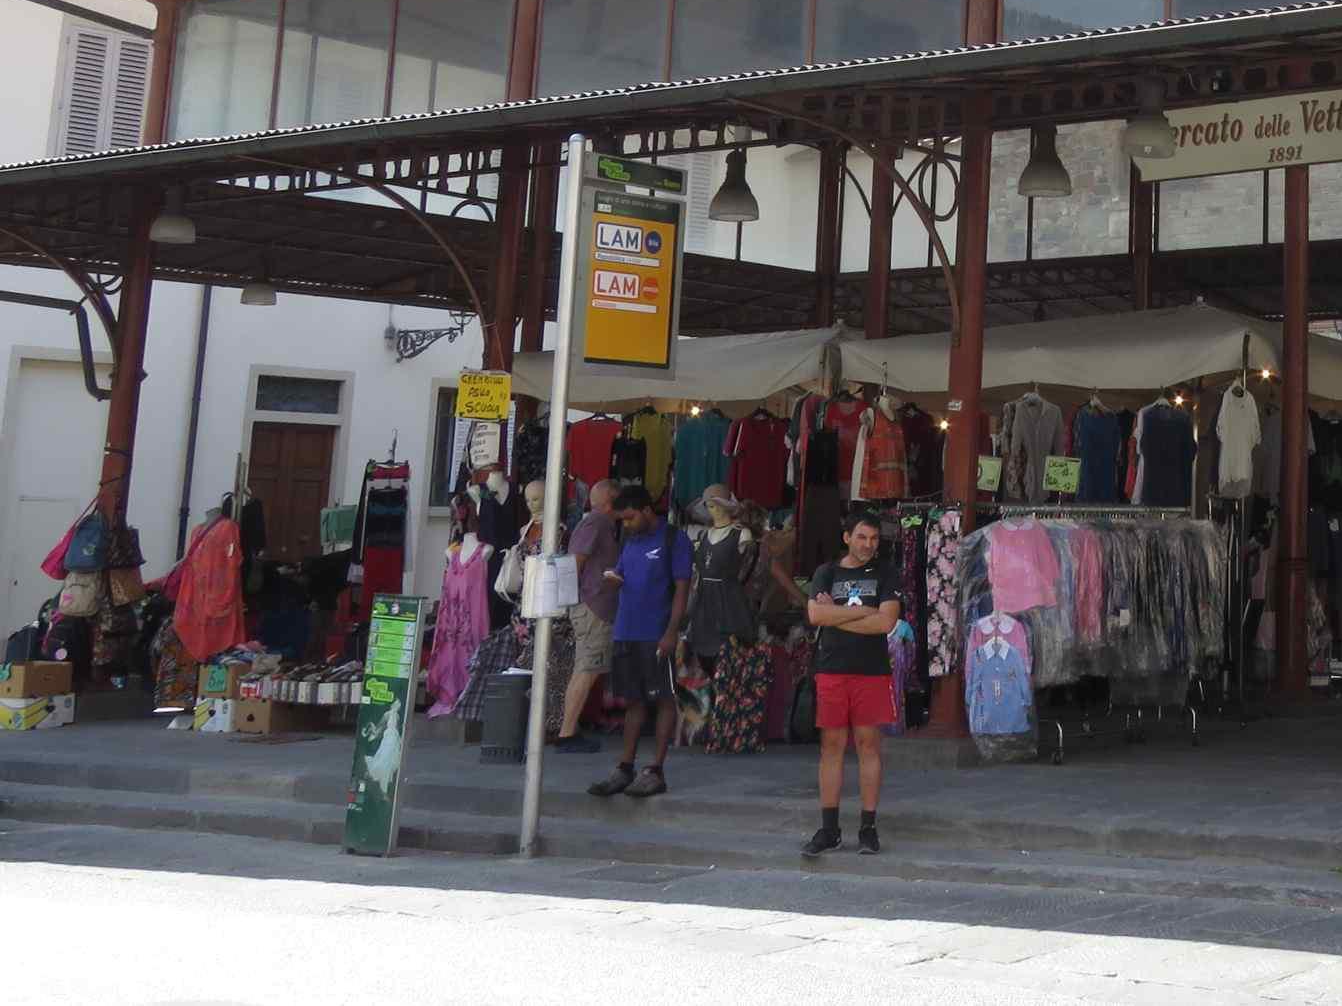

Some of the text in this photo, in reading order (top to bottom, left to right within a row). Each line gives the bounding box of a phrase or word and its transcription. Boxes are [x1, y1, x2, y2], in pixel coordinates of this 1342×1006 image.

[1254, 113, 1292, 140] delle
[1268, 144, 1303, 163] 1891
[600, 226, 640, 250] LAM
[597, 273, 637, 296] LAM
